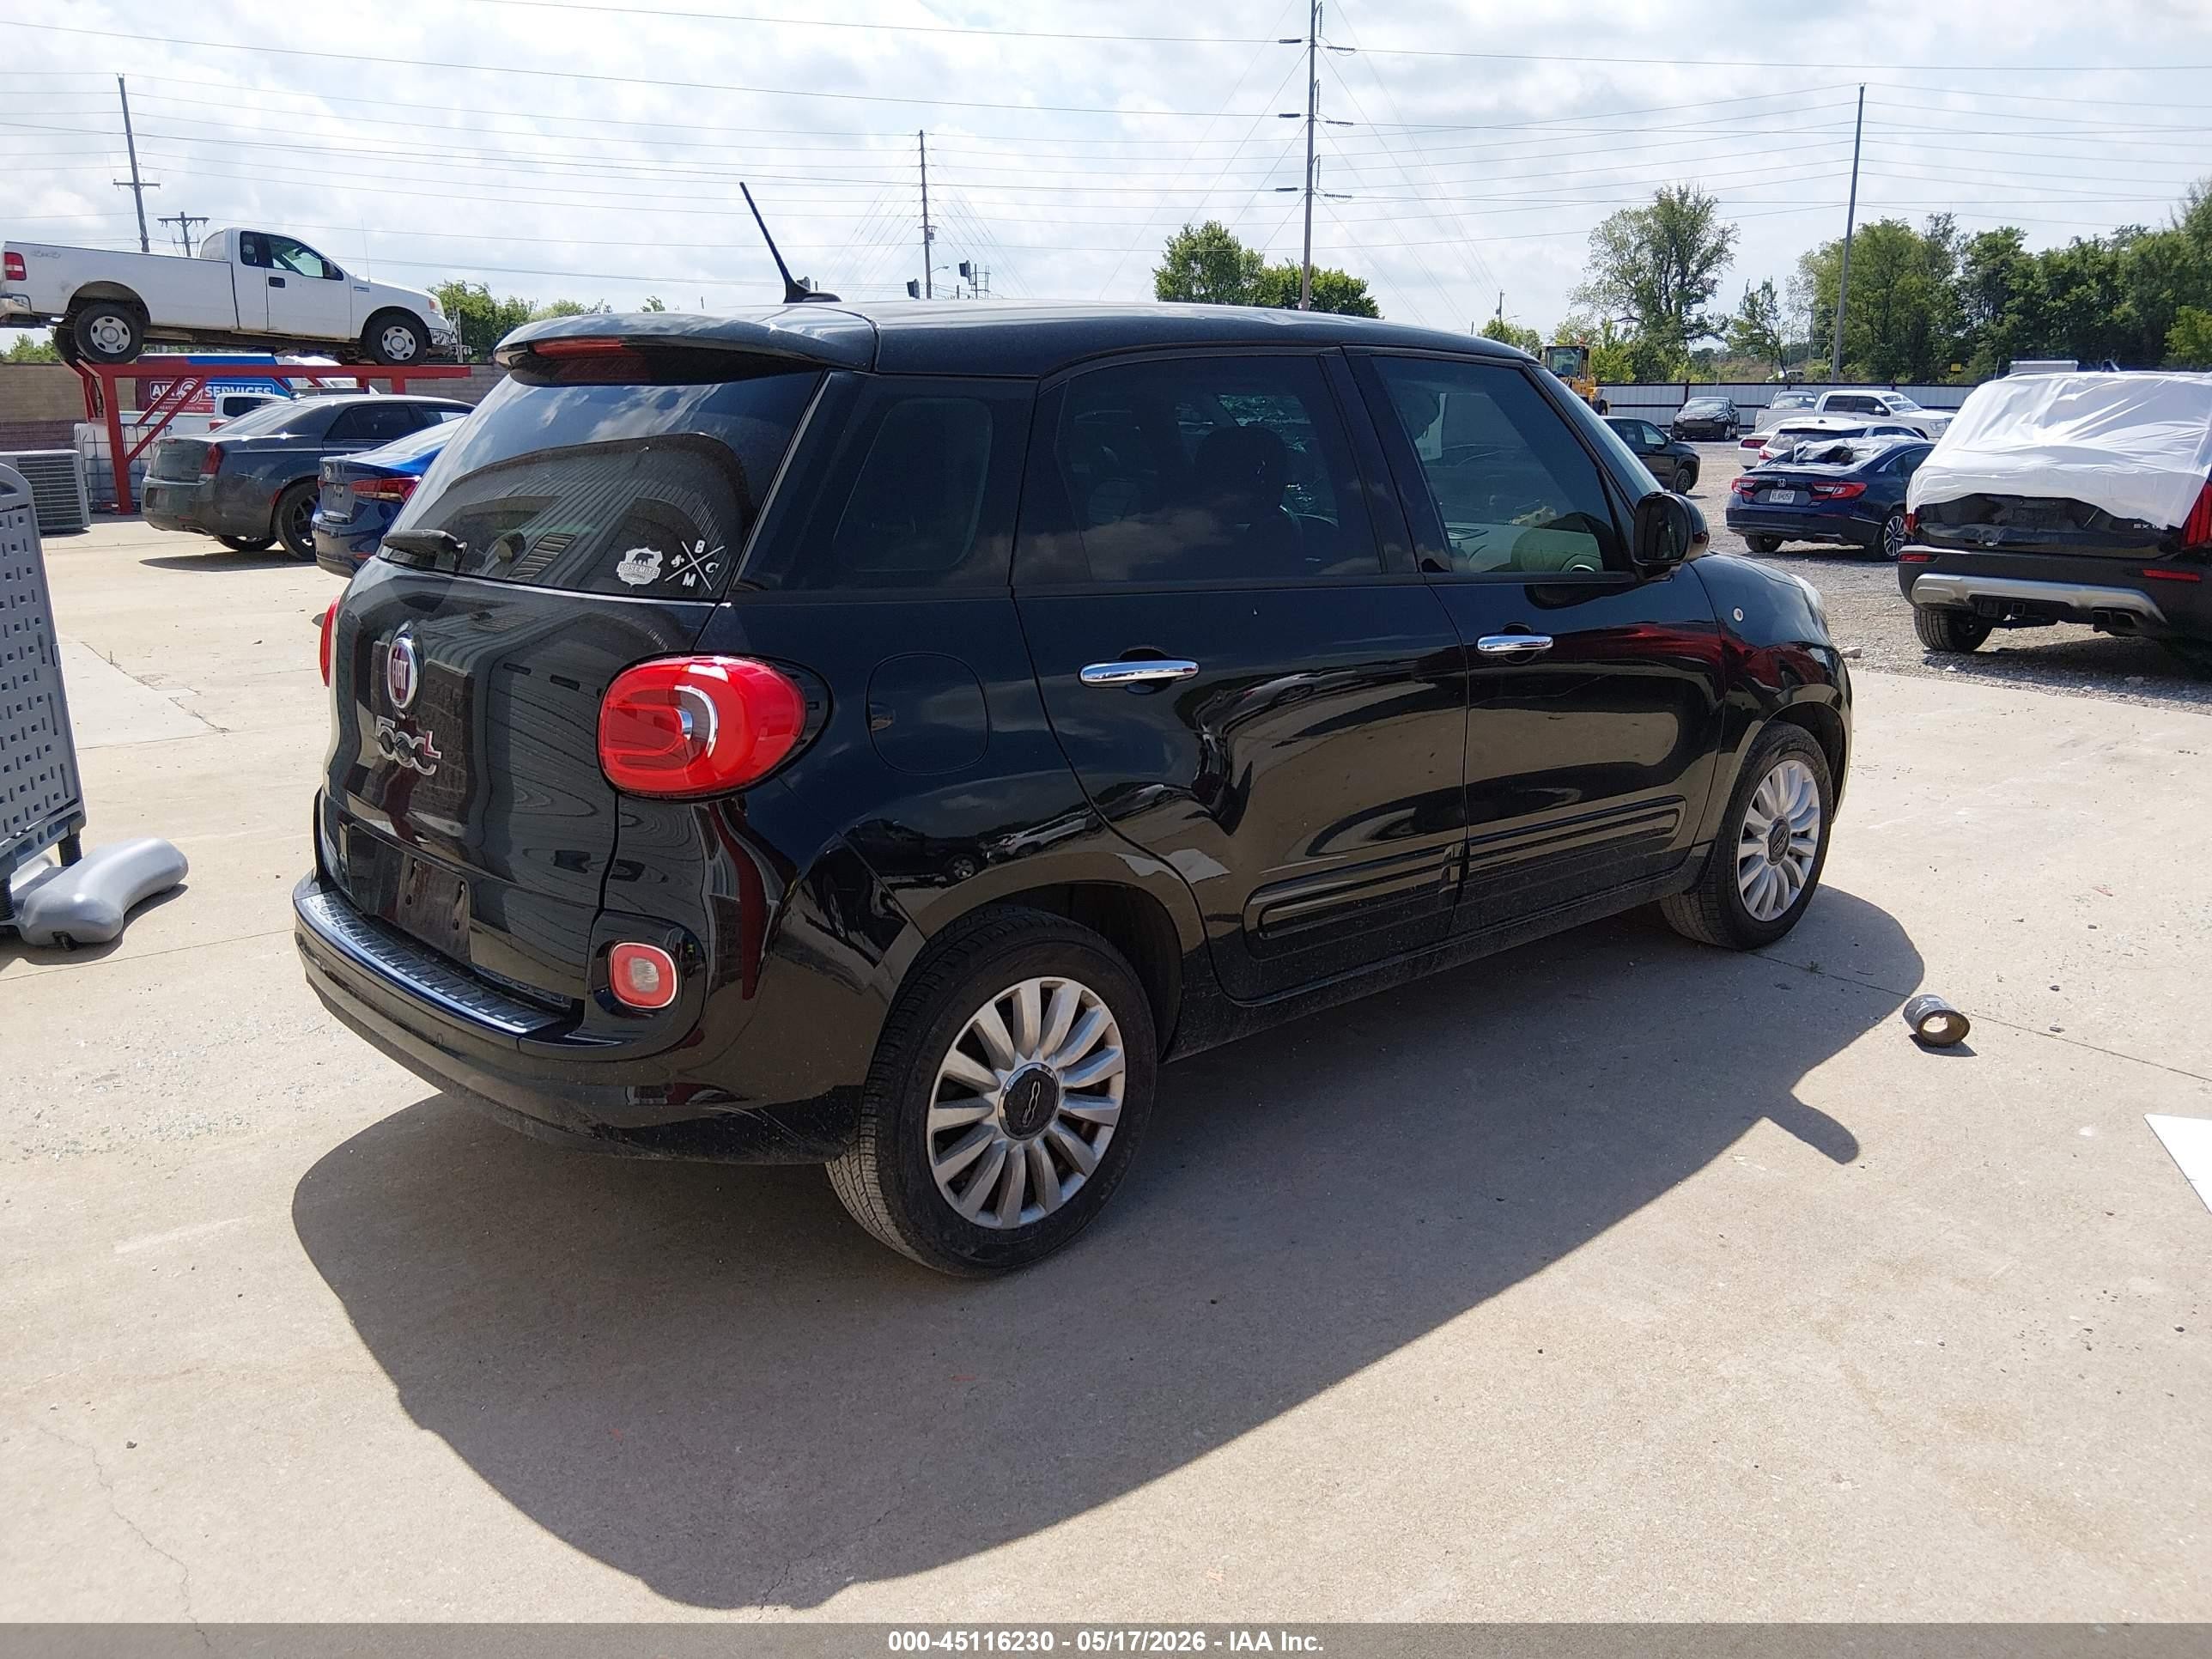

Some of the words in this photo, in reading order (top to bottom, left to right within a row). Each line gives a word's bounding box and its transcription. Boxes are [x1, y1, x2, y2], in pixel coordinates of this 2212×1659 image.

[695, 539, 706, 554] B
[705, 562, 720, 574] C
[682, 572, 696, 587] M
[392, 658, 409, 690] FIAT
[375, 714, 442, 776] 500L
